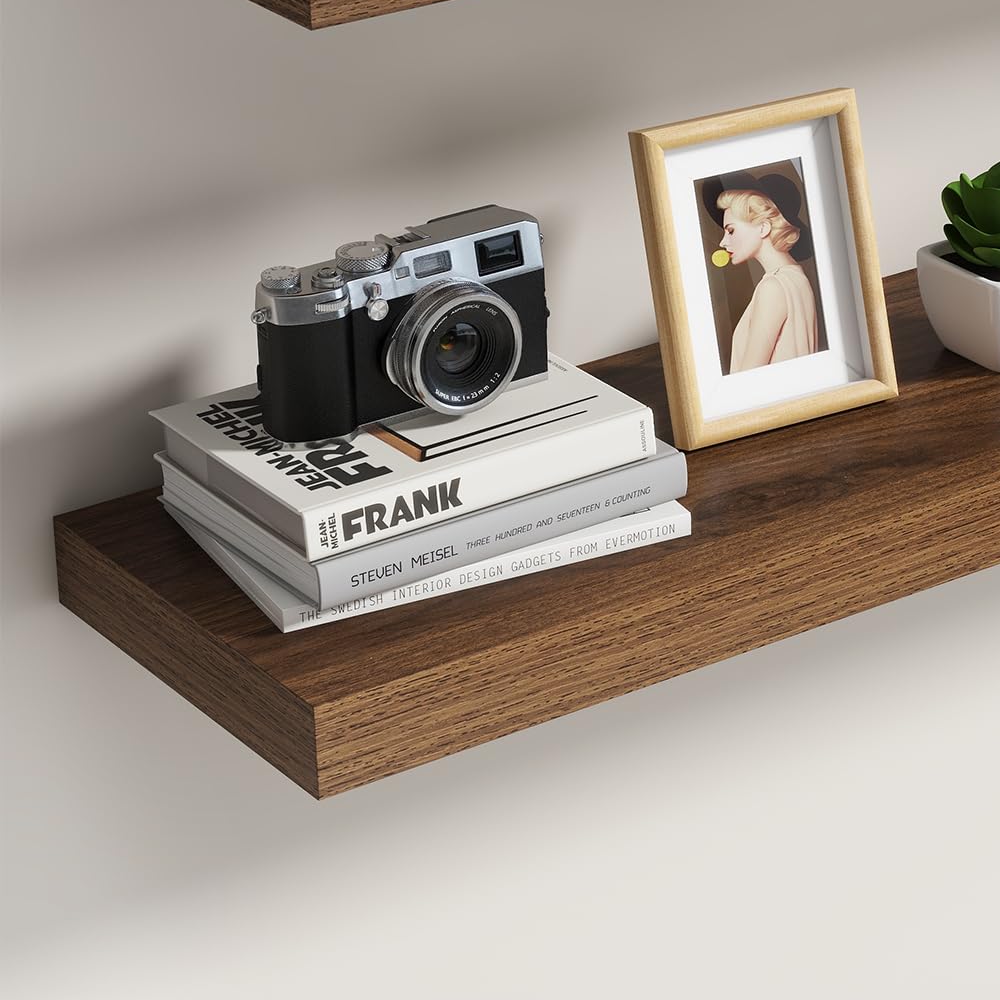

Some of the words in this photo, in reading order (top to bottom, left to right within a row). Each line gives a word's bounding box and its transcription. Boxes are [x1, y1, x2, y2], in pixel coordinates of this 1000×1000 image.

[435, 388, 450, 401] SUPER
[196, 403, 342, 491] JEAN-MICHEL
[327, 512, 339, 549] MICHEL
[341, 477, 463, 542] FRANK
[350, 561, 402, 588] STEVEN
[411, 545, 458, 568] MEISEL
[466, 535, 491, 550] THREE
[495, 522, 532, 541] HUNDRED
[536, 517, 553, 529] AND
[557, 502, 601, 522] SEVENTEEN
[611, 486, 651, 505] COUNTING
[299, 609, 322, 623] THE
[330, 593, 384, 616] SWEDISH
[393, 577, 452, 601] INTERIOR
[459, 565, 503, 585] DESIGN
[511, 550, 562, 572] GADGETS
[569, 542, 598, 559] FROM
[605, 523, 676, 550] EVERMOTION
